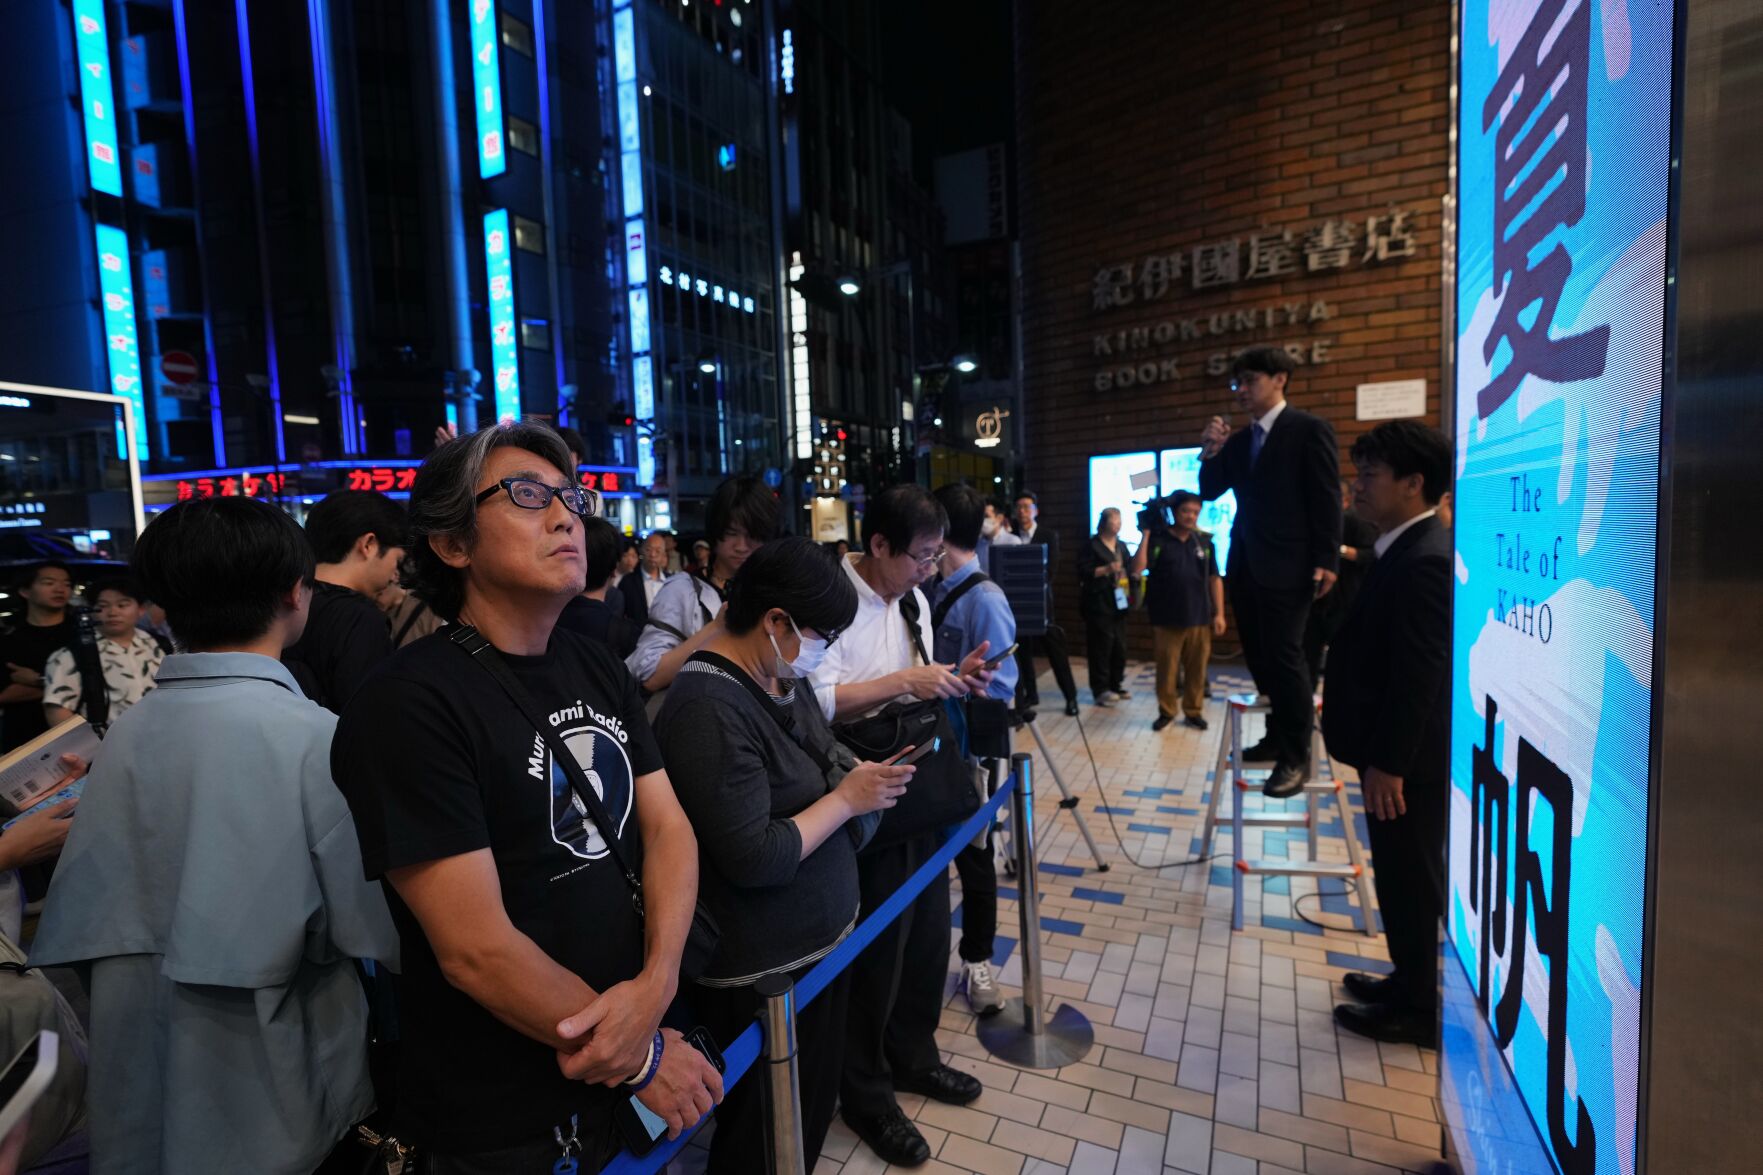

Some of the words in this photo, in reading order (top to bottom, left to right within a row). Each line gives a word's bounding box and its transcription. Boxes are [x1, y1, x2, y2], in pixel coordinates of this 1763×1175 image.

[1477, 0, 1610, 421] 夏
[1093, 206, 1420, 309] 紀伊國屋書店
[101, 252, 137, 392] カラオケ
[488, 229, 518, 426] カラオケ
[1094, 301, 1331, 355] KINOKUNIYA
[1094, 358, 1182, 392] BOOK
[1207, 340, 1332, 376] SRE
[1510, 472, 1542, 512] The
[1496, 533, 1530, 574] Tale
[1539, 535, 1562, 580] of
[1497, 588, 1552, 644] KAHO
[528, 699, 584, 781] Murami
[1469, 693, 1597, 1175] 帆
